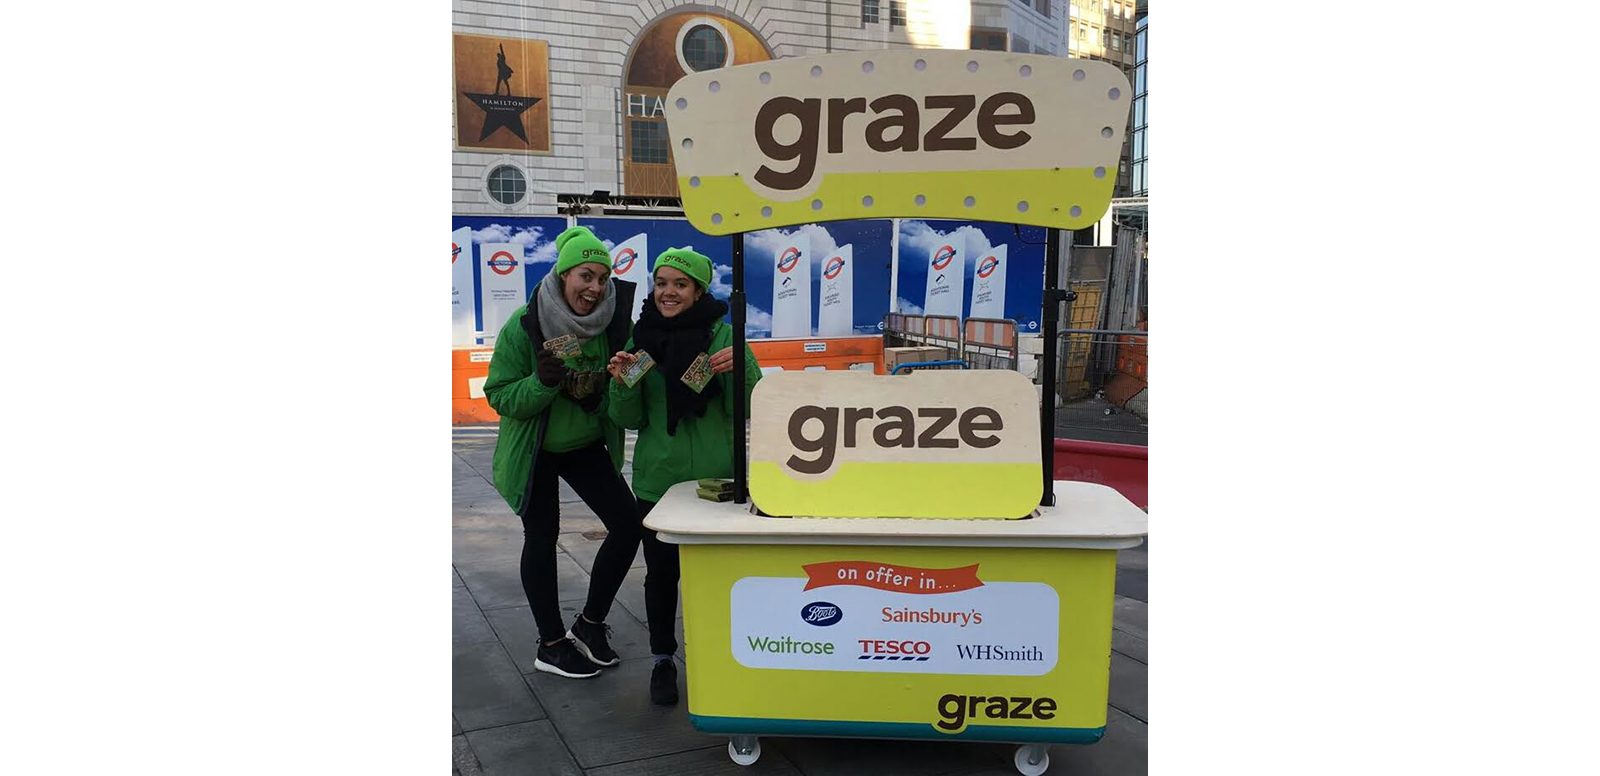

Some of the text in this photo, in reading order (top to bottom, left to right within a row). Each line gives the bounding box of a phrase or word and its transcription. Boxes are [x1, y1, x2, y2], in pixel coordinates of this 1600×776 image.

[482, 98, 524, 107] HAMILTON
[753, 91, 1036, 190] graze
[663, 254, 692, 269] graze
[545, 336, 569, 350] graze
[684, 358, 702, 381] graze
[786, 405, 1004, 474] graze
[837, 566, 956, 589] on offer in...
[805, 605, 837, 622] Boots
[881, 606, 983, 628] Sainsbury's
[747, 635, 835, 655] Waitrose
[858, 640, 932, 655] TESCO
[956, 644, 1044, 662] WHSmith
[936, 692, 1058, 730] graze
